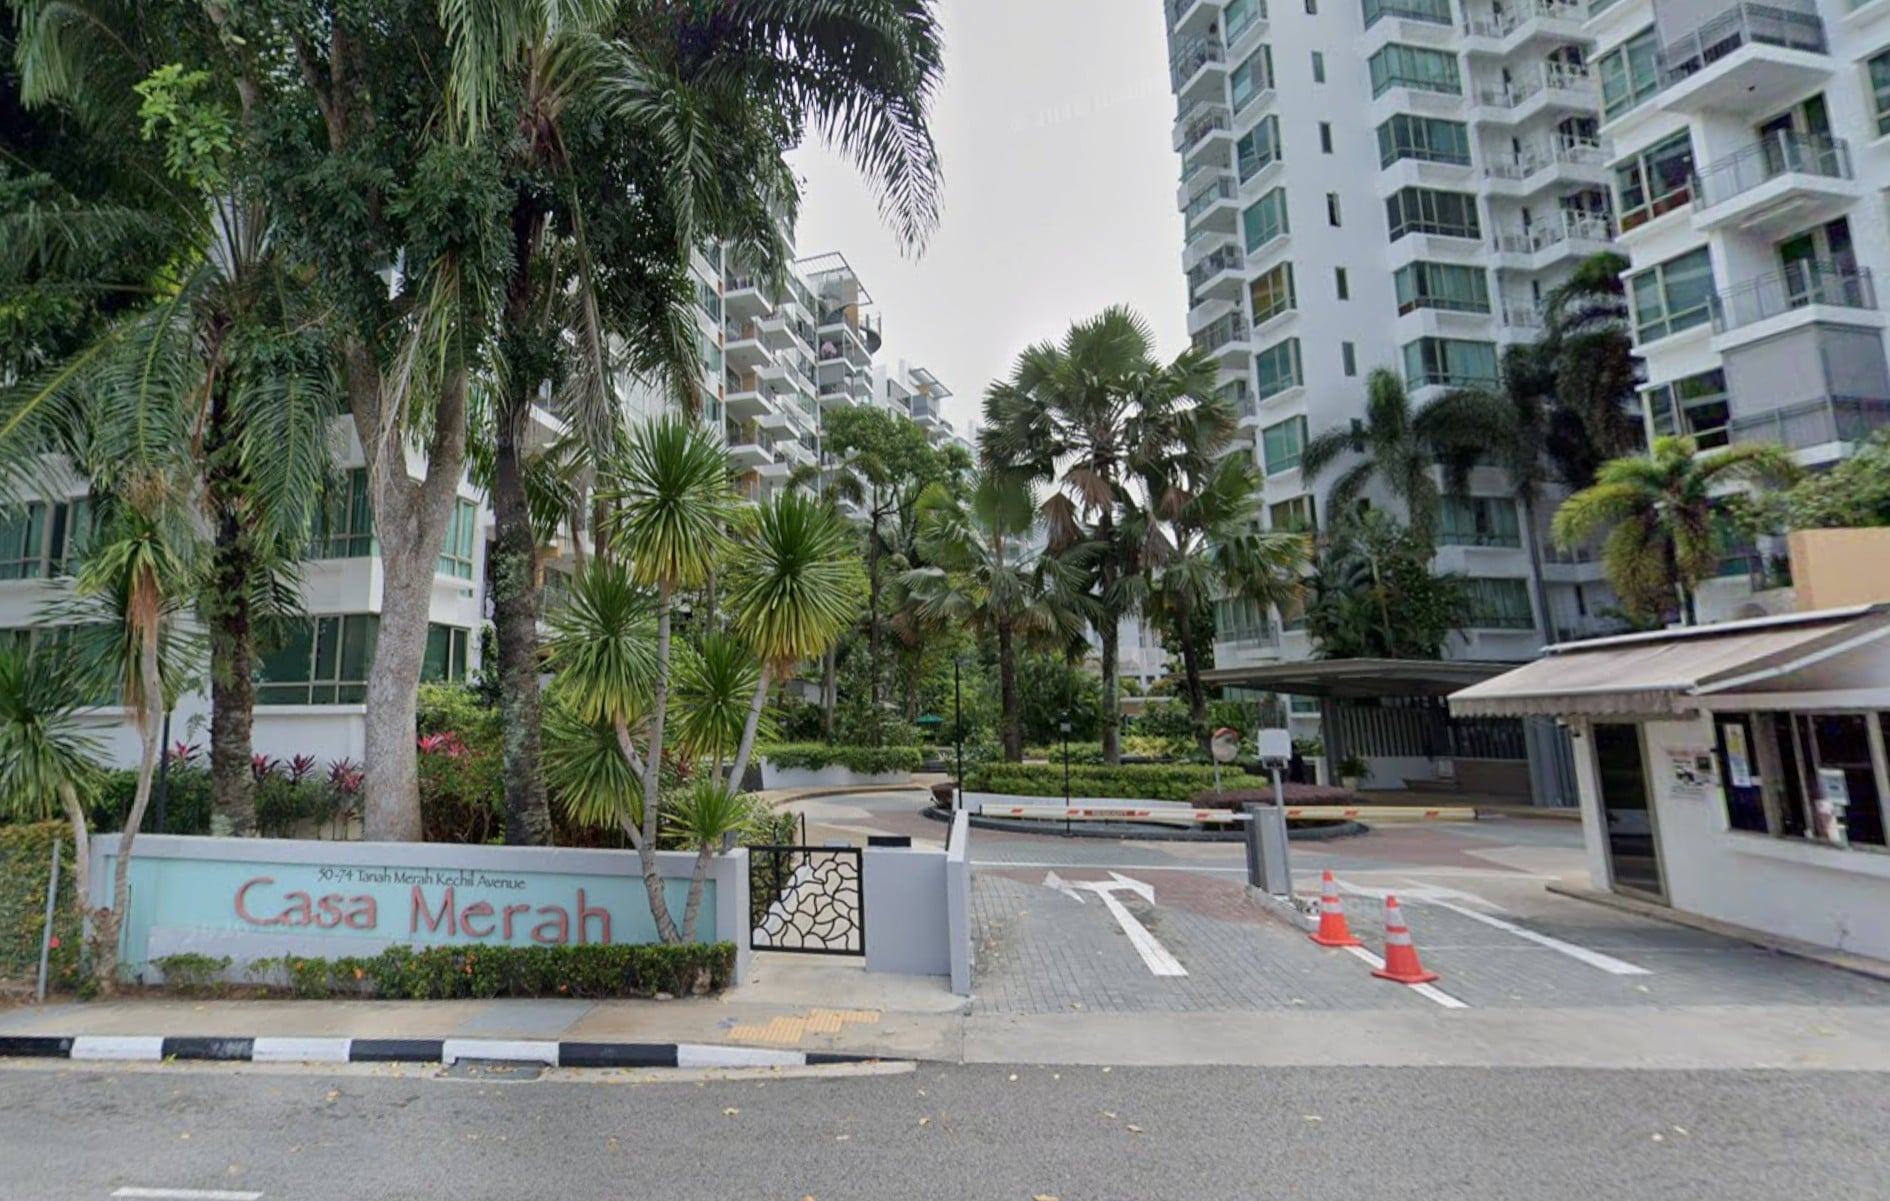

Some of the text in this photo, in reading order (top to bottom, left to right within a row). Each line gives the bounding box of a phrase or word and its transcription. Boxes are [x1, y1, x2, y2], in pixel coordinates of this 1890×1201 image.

[356, 867, 392, 882] Tanah
[395, 868, 433, 885] Merah
[436, 869, 475, 888] Kechil
[477, 874, 527, 889] Avenue
[234, 876, 611, 944] Casa Merah
